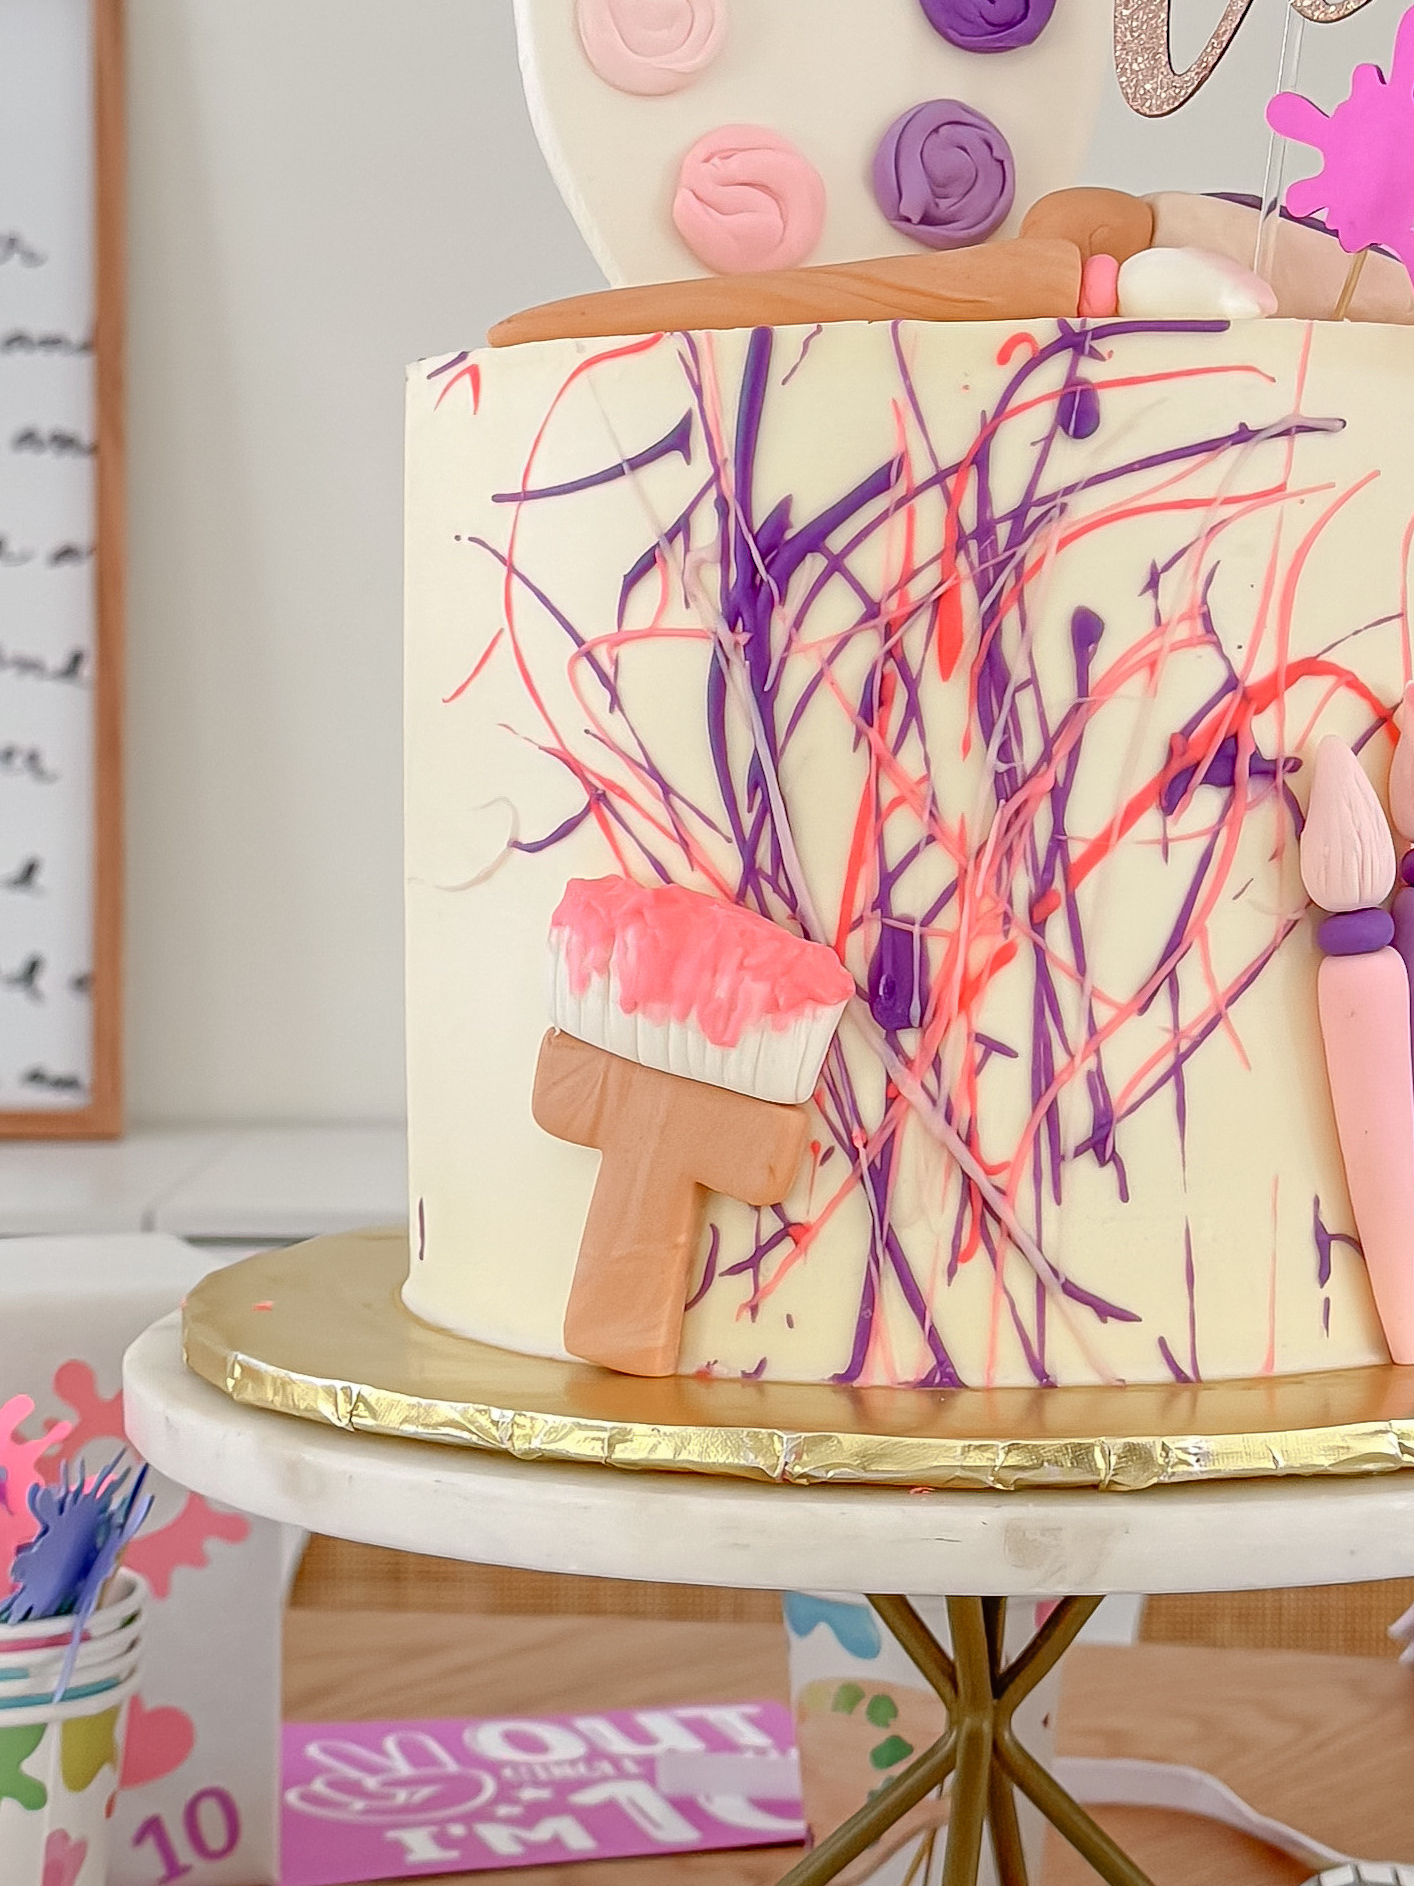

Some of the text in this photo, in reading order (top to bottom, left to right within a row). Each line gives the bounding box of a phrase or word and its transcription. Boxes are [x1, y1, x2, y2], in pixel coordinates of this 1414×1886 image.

[463, 1702, 775, 1764] OUT
[133, 1786, 241, 1886] 10
[384, 1814, 599, 1864] I'M
